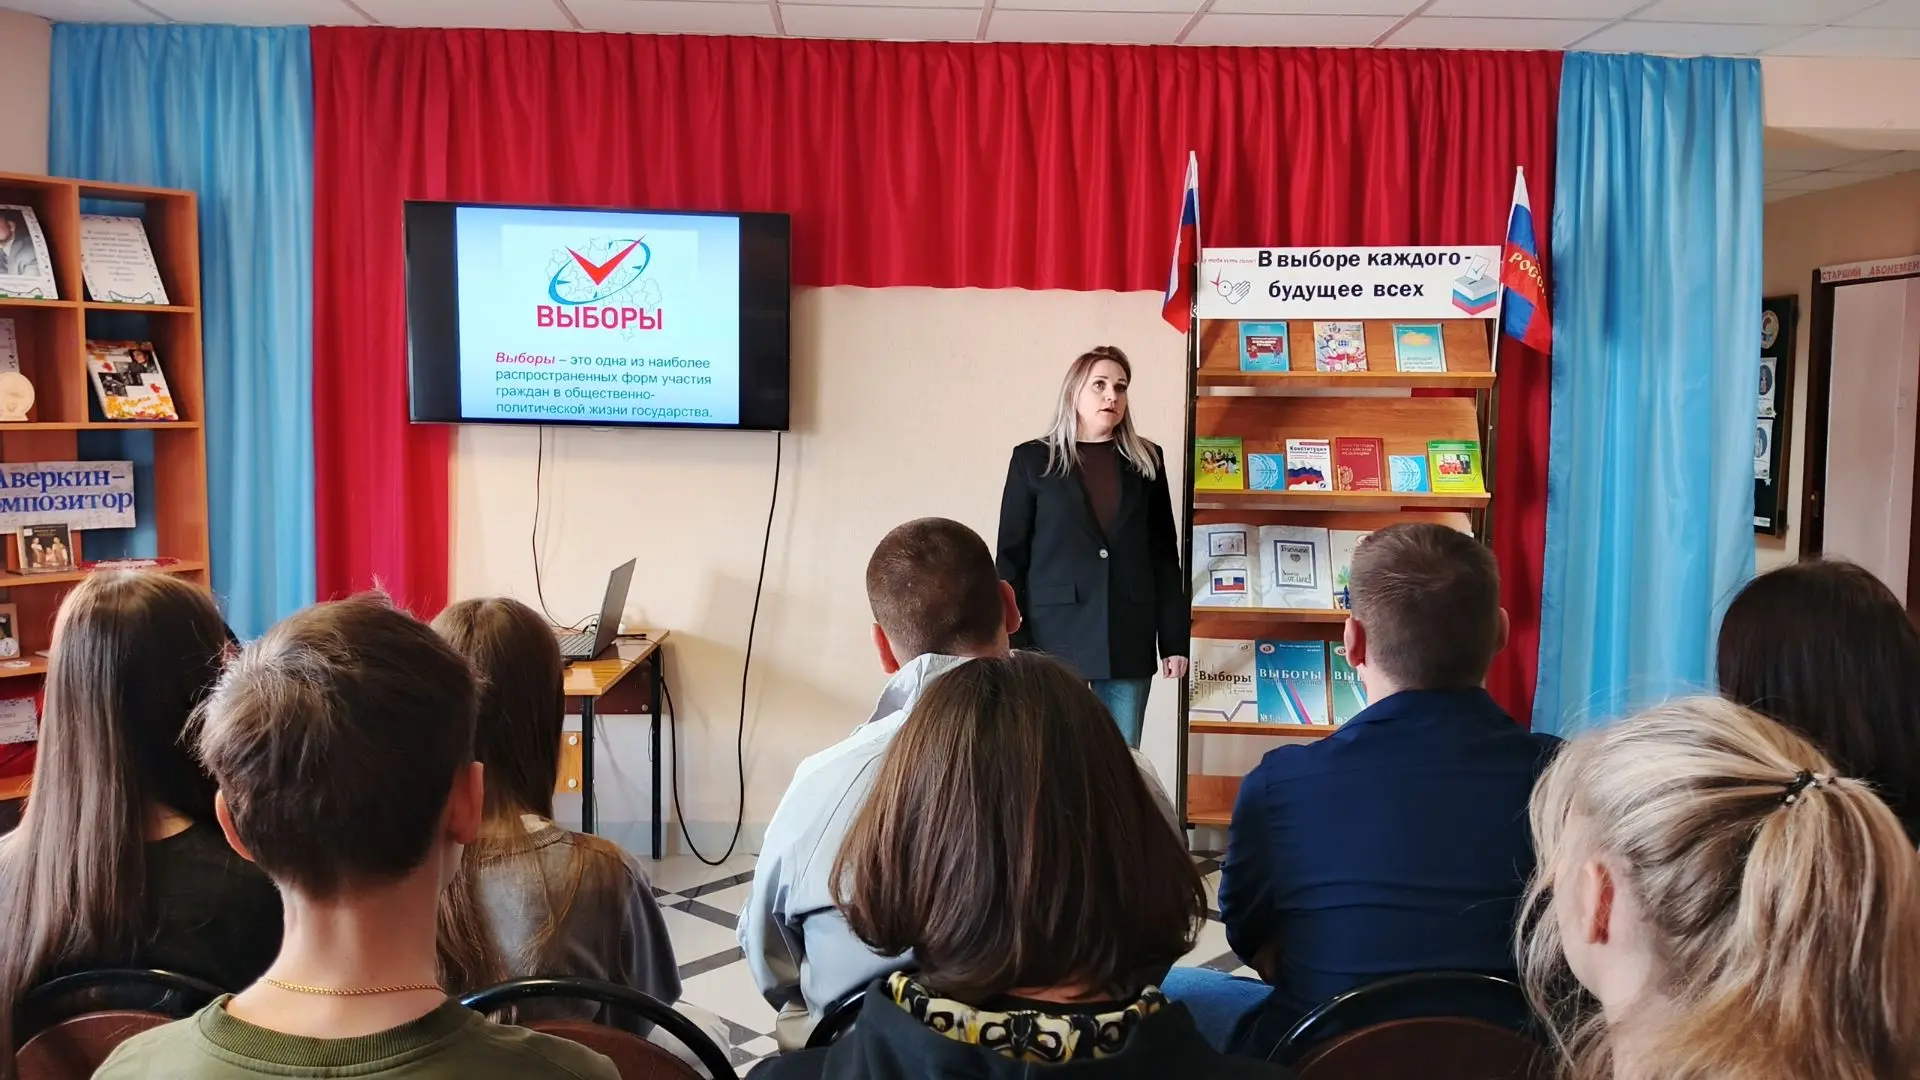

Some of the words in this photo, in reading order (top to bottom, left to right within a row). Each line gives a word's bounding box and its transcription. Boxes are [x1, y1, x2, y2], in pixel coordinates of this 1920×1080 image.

[1258, 250, 1273, 268] В
[1277, 250, 1361, 270] выборе
[1869, 261, 1920, 276] АБОНЕМЕН
[1268, 281, 1363, 301] будущее
[1373, 284, 1424, 297] всех
[536, 304, 663, 330] ВЫБОРЫ
[495, 352, 556, 367] Выборы
[570, 356, 592, 366] это
[595, 356, 627, 368] одна
[630, 358, 645, 367] из
[648, 356, 710, 368] наиболее
[495, 370, 618, 384] распространенных
[621, 371, 658, 385] форм
[662, 374, 712, 386] участия
[496, 387, 550, 400] граждан
[553, 389, 561, 397] в
[564, 387, 655, 402] общественно-
[496, 402, 585, 415] политической
[589, 404, 628, 415] жизни
[632, 406, 713, 420] государства.
[0, 491, 133, 513] мпозитор
[1199, 670, 1252, 685] Выборы
[1259, 668, 1321, 680] ВЫБОРЫ
